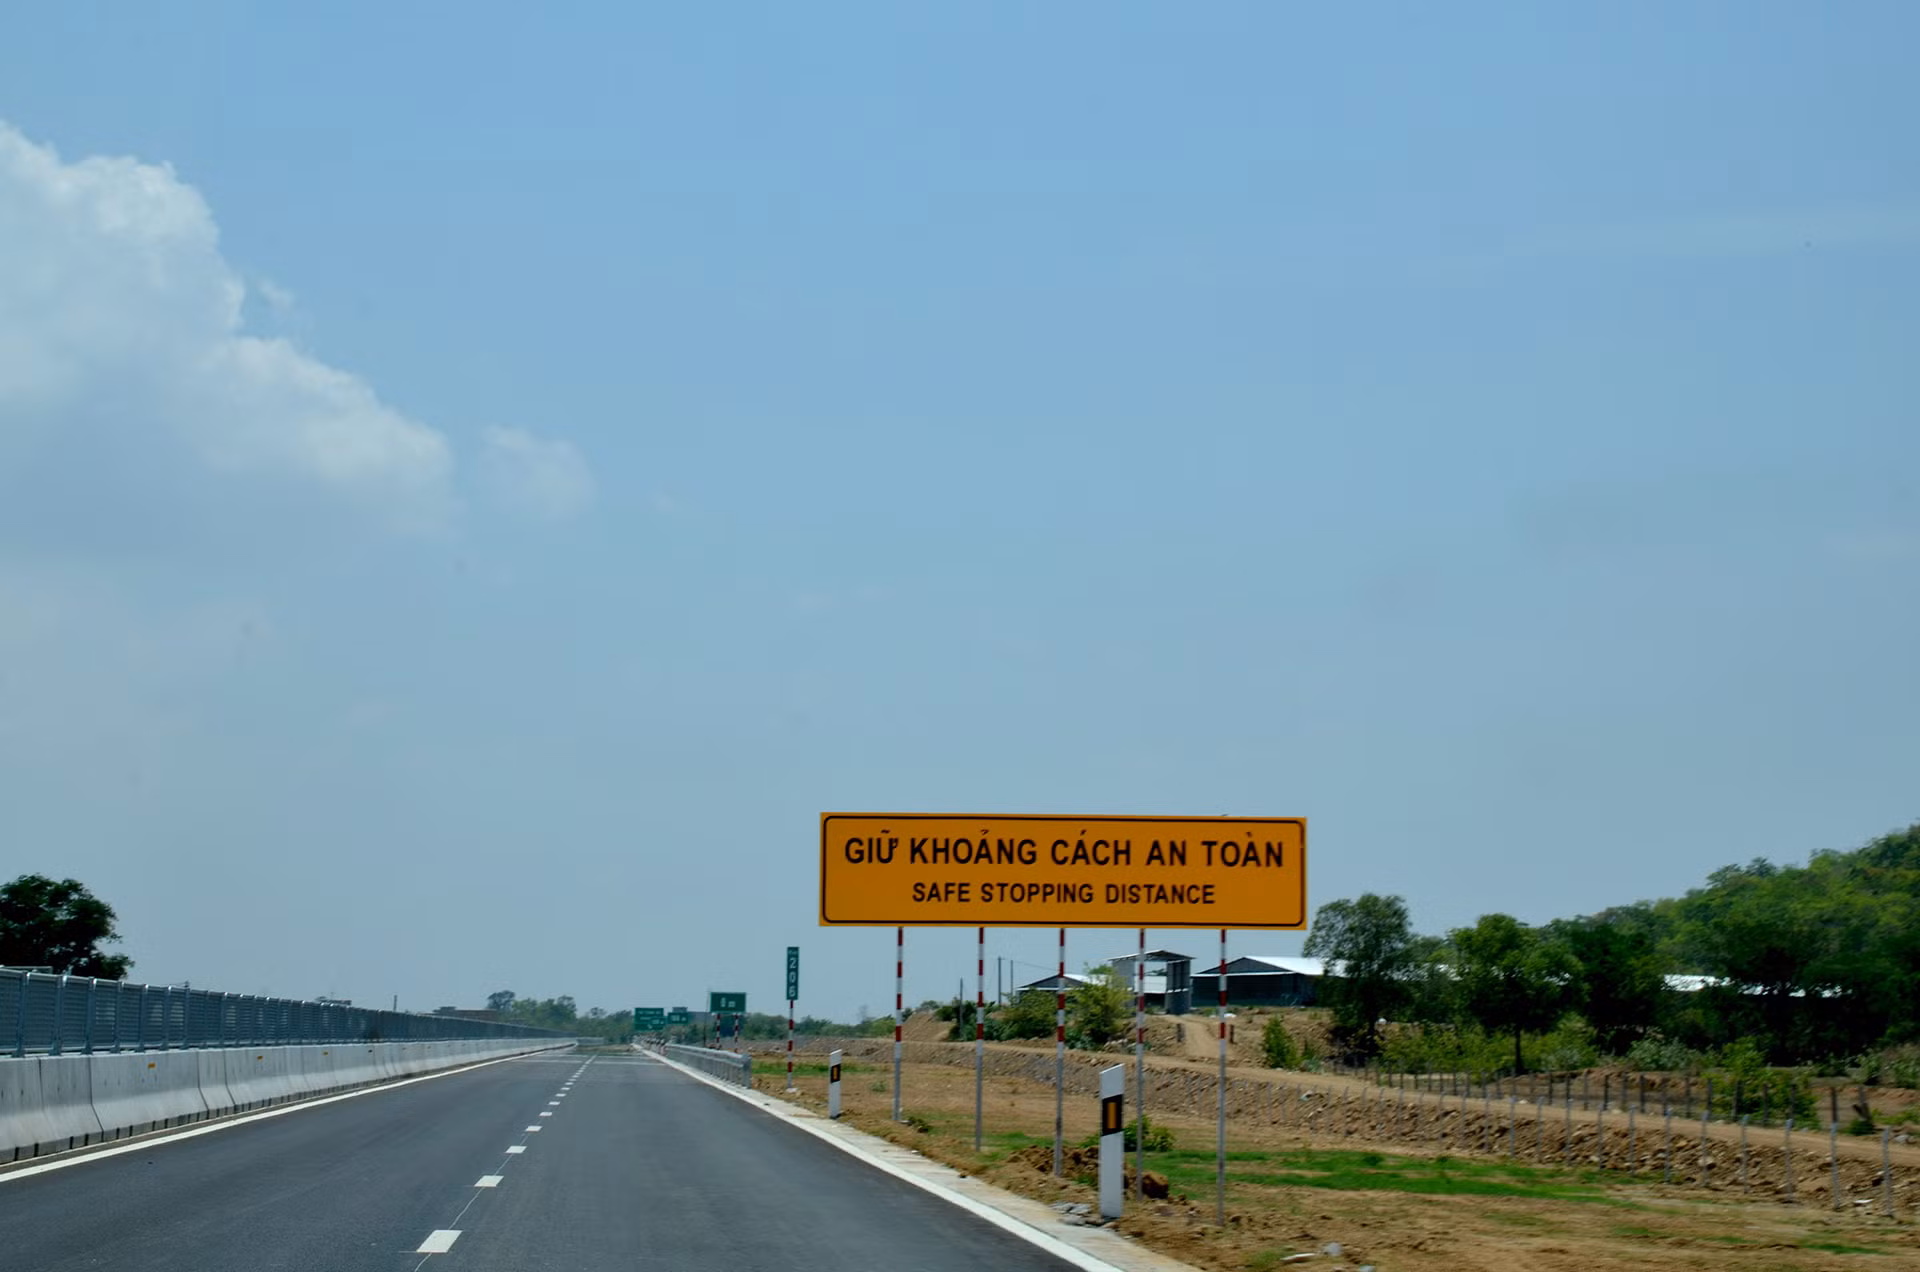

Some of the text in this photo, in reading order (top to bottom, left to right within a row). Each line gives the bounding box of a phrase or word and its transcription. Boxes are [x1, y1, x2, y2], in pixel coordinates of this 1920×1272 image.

[844, 829, 1284, 868] GIỮ KHOẢNG CÁCH AN TOÀN
[911, 881, 1216, 905] SAFE STOPPING DISTANCE
